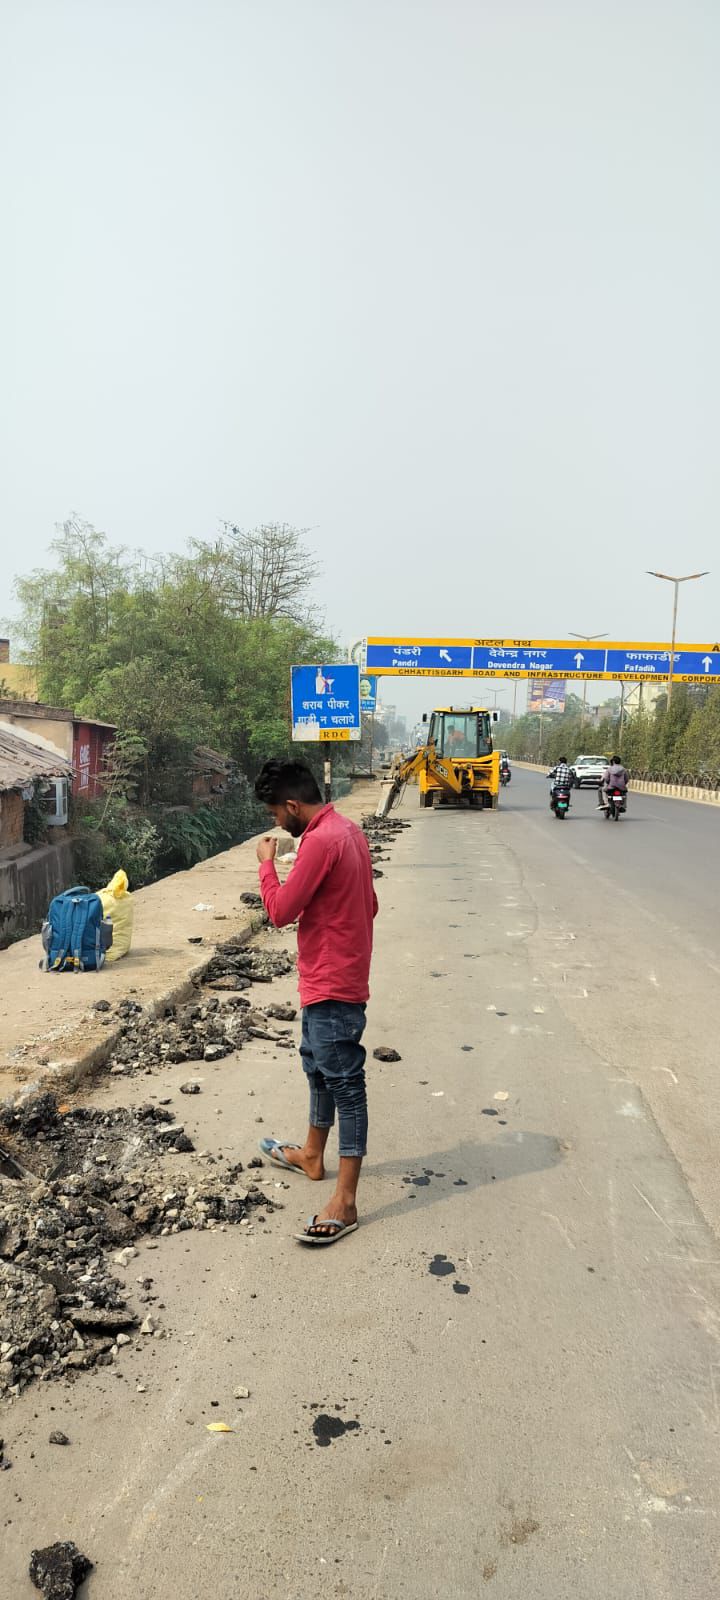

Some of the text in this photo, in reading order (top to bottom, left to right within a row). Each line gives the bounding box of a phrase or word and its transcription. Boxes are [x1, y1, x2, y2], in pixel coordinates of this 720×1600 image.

[393, 646, 422, 656] पंडरी
[488, 647, 547, 658] देवेन्द्र नगर
[392, 659, 418, 667] Pandri
[487, 661, 553, 670] Devendra Nagar
[624, 664, 656, 672] Fafadih
[527, 671, 603, 679] INFRASTRUCTURE
[612, 673, 674, 681] DEVELOPMEN
[302, 700, 323, 710] शराब
[327, 697, 350, 710] पीकर
[320, 716, 328, 724] न
